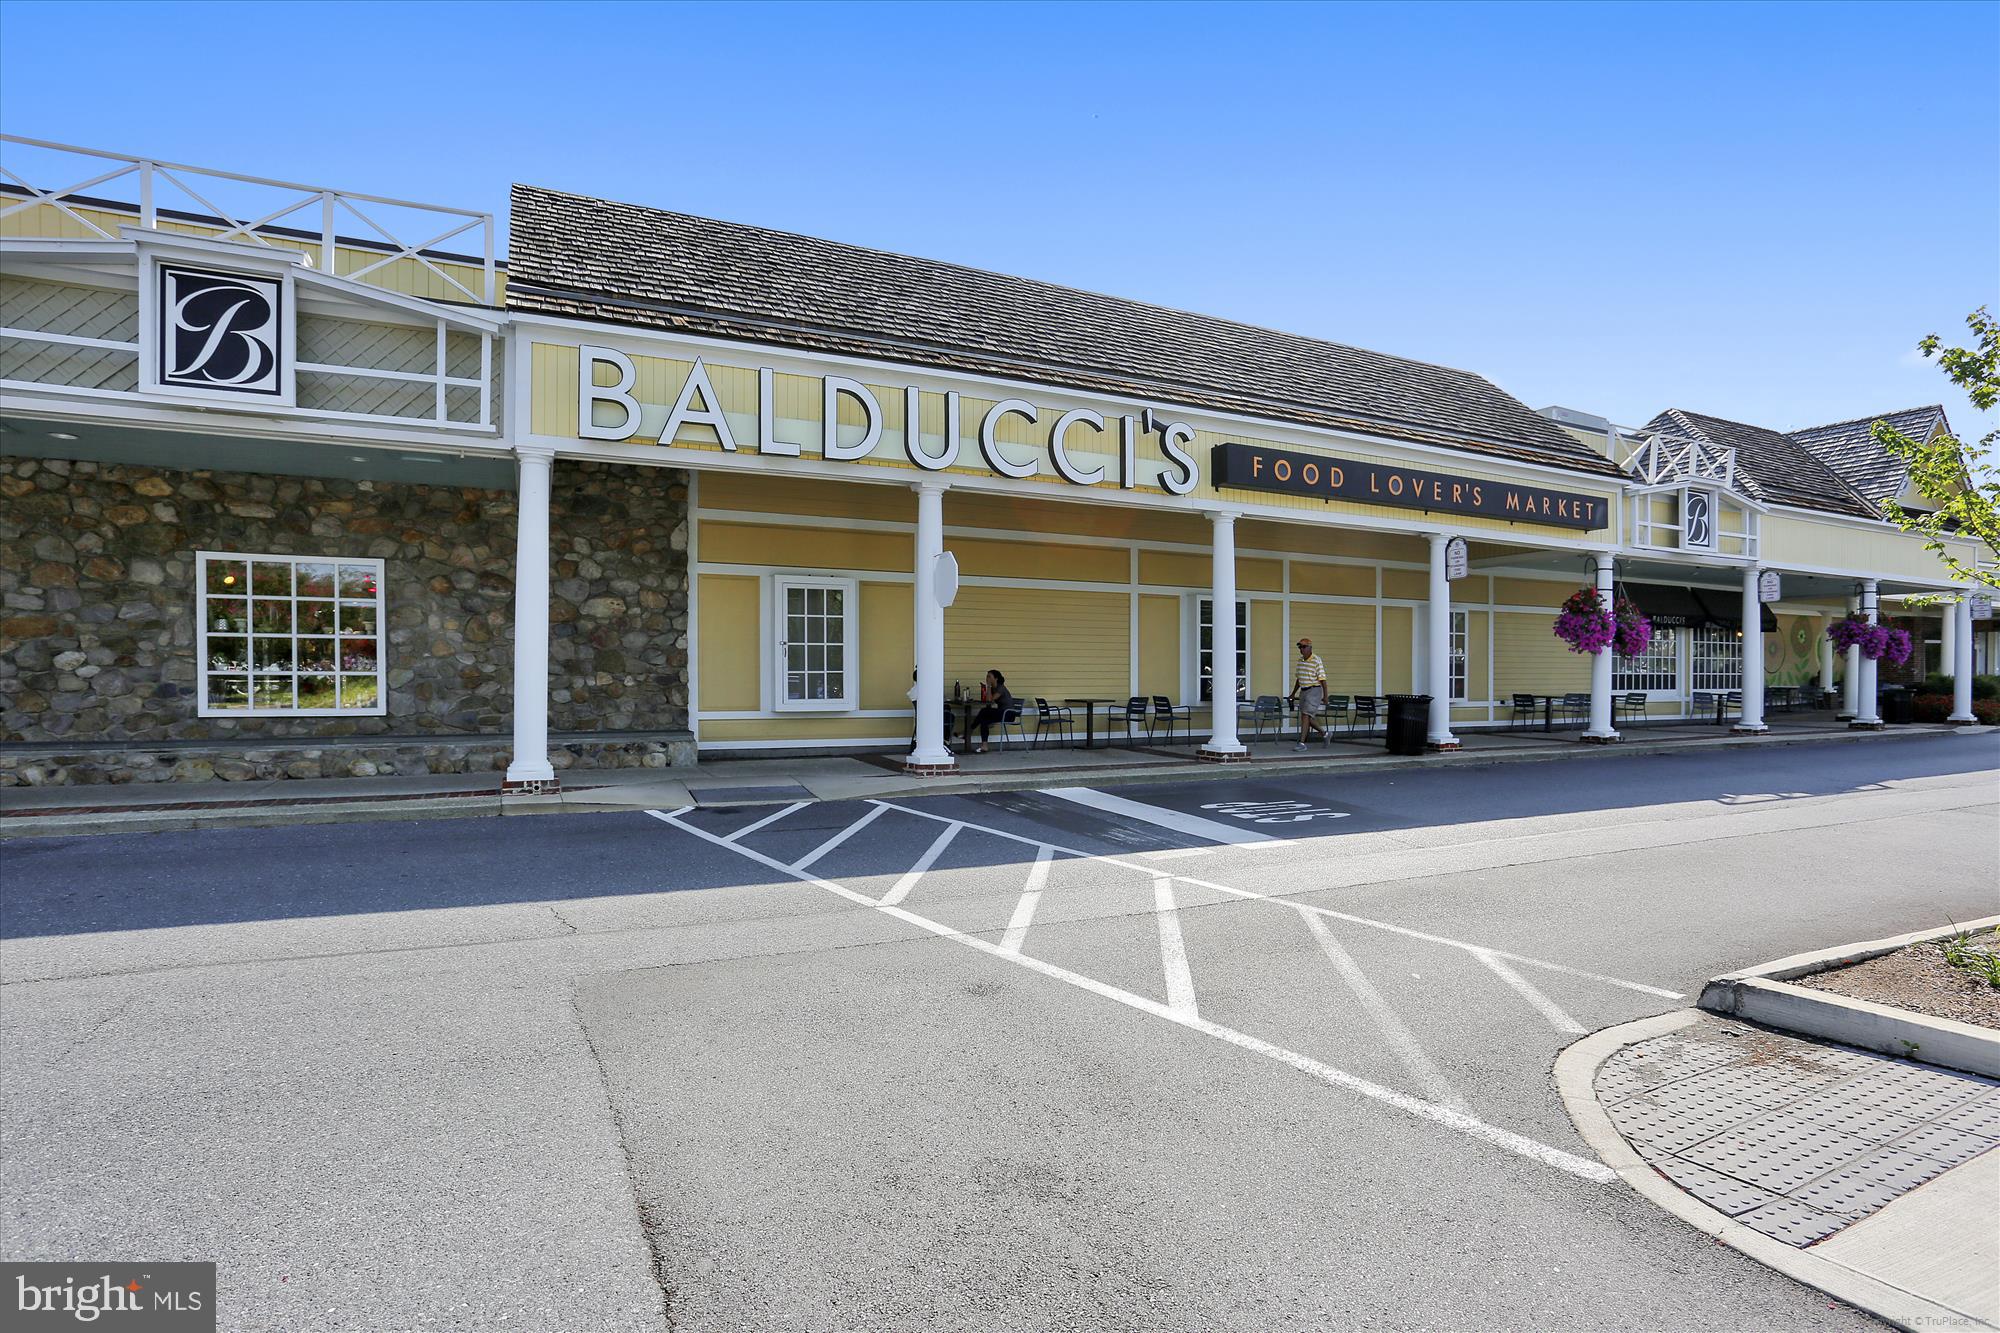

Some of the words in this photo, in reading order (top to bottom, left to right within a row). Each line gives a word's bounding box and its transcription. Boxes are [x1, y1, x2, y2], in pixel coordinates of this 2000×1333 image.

[167, 271, 276, 389] B
[578, 344, 1200, 496] BALDUCCI'S
[1252, 456, 1344, 488] FOOD
[1370, 472, 1482, 506] LOVER'S
[1505, 491, 1594, 520] MARKET
